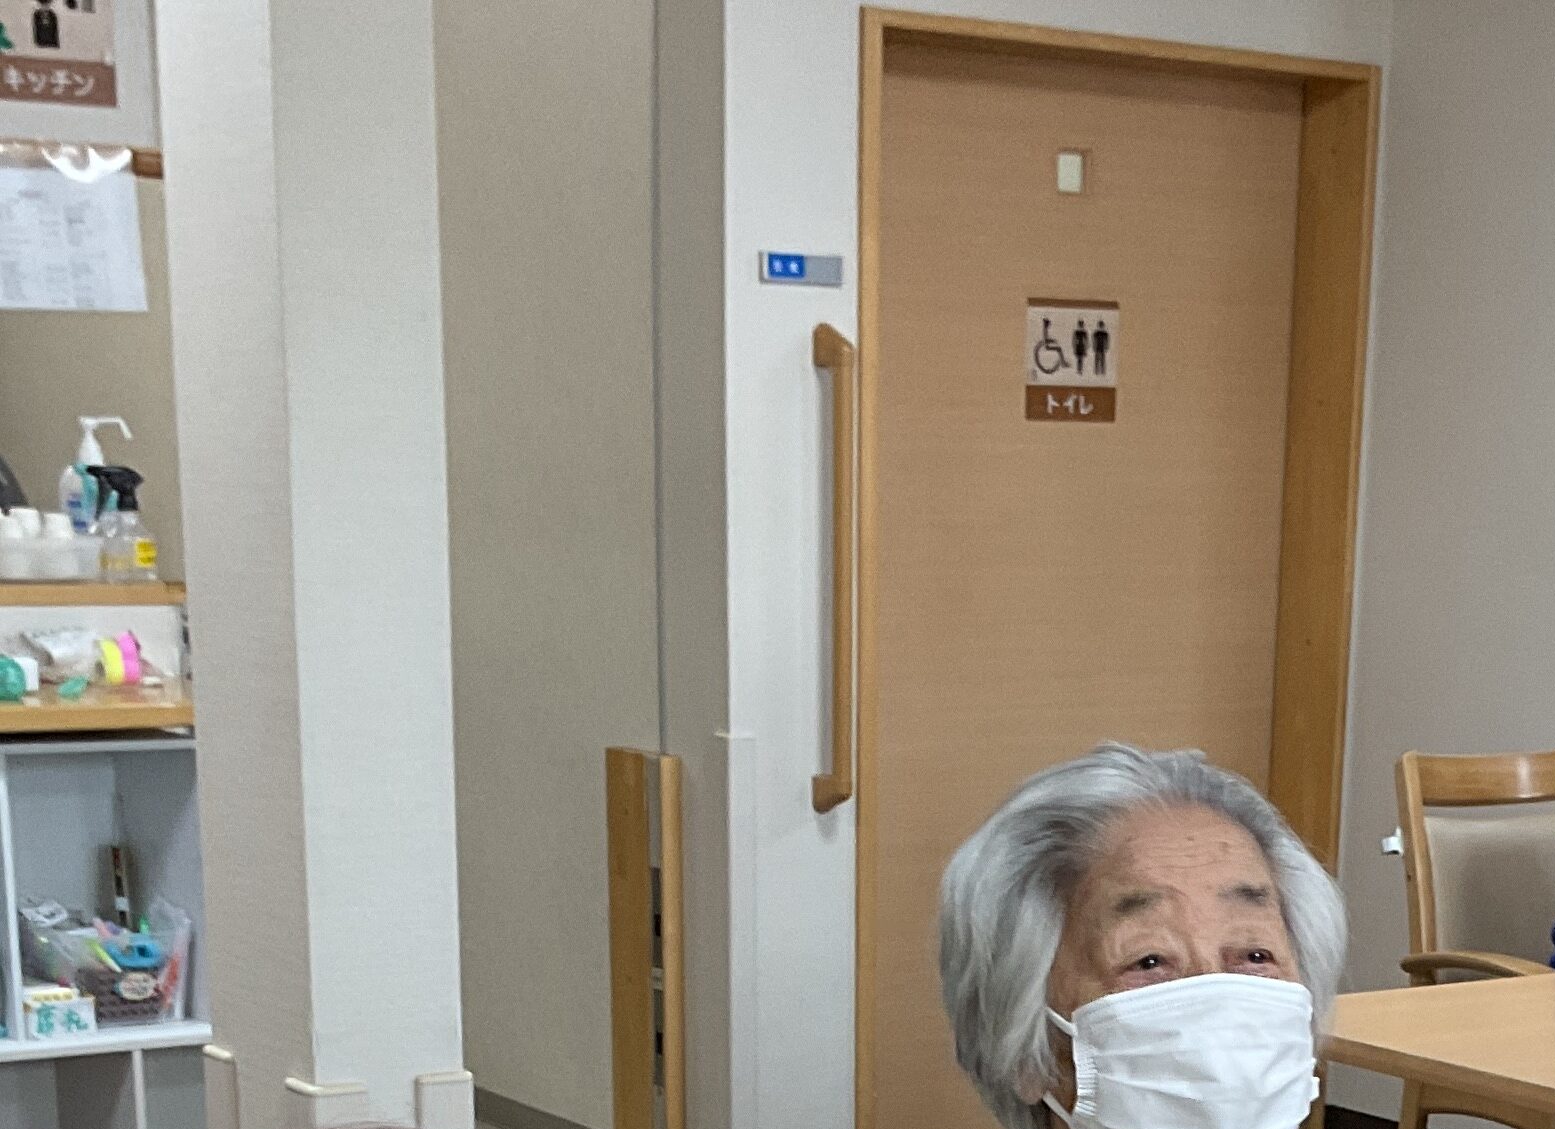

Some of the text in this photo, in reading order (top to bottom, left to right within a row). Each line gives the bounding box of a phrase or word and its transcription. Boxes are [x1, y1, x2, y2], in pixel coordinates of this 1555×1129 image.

[3, 64, 95, 97] キッチン
[1046, 393, 1094, 415] トイレ
